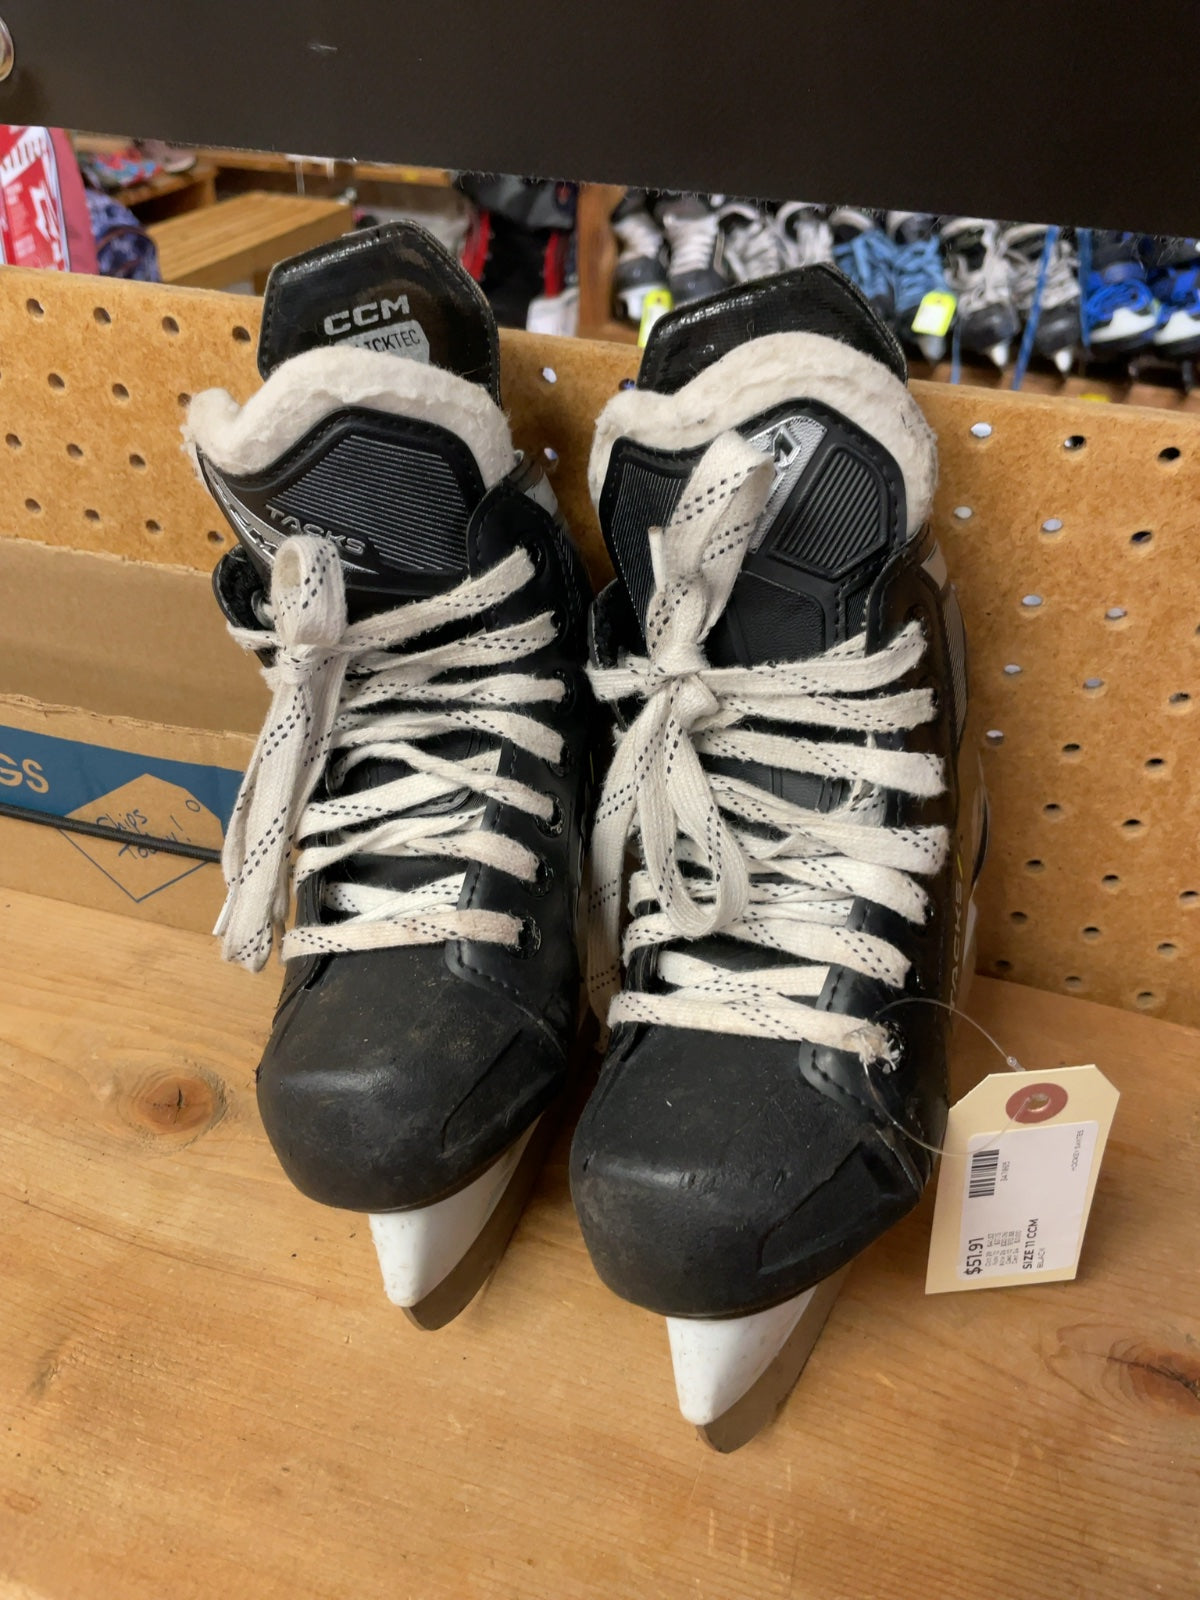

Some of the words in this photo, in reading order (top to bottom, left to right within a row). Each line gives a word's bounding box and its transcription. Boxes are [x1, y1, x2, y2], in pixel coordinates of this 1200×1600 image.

[324, 294, 410, 336] CCM
[265, 504, 366, 555] TACKS
[1025, 1239, 1035, 1248] 11
[1027, 1219, 1038, 1239] CCM
[963, 1237, 984, 1276] $51.91
[1023, 1249, 1035, 1269] SIZE
